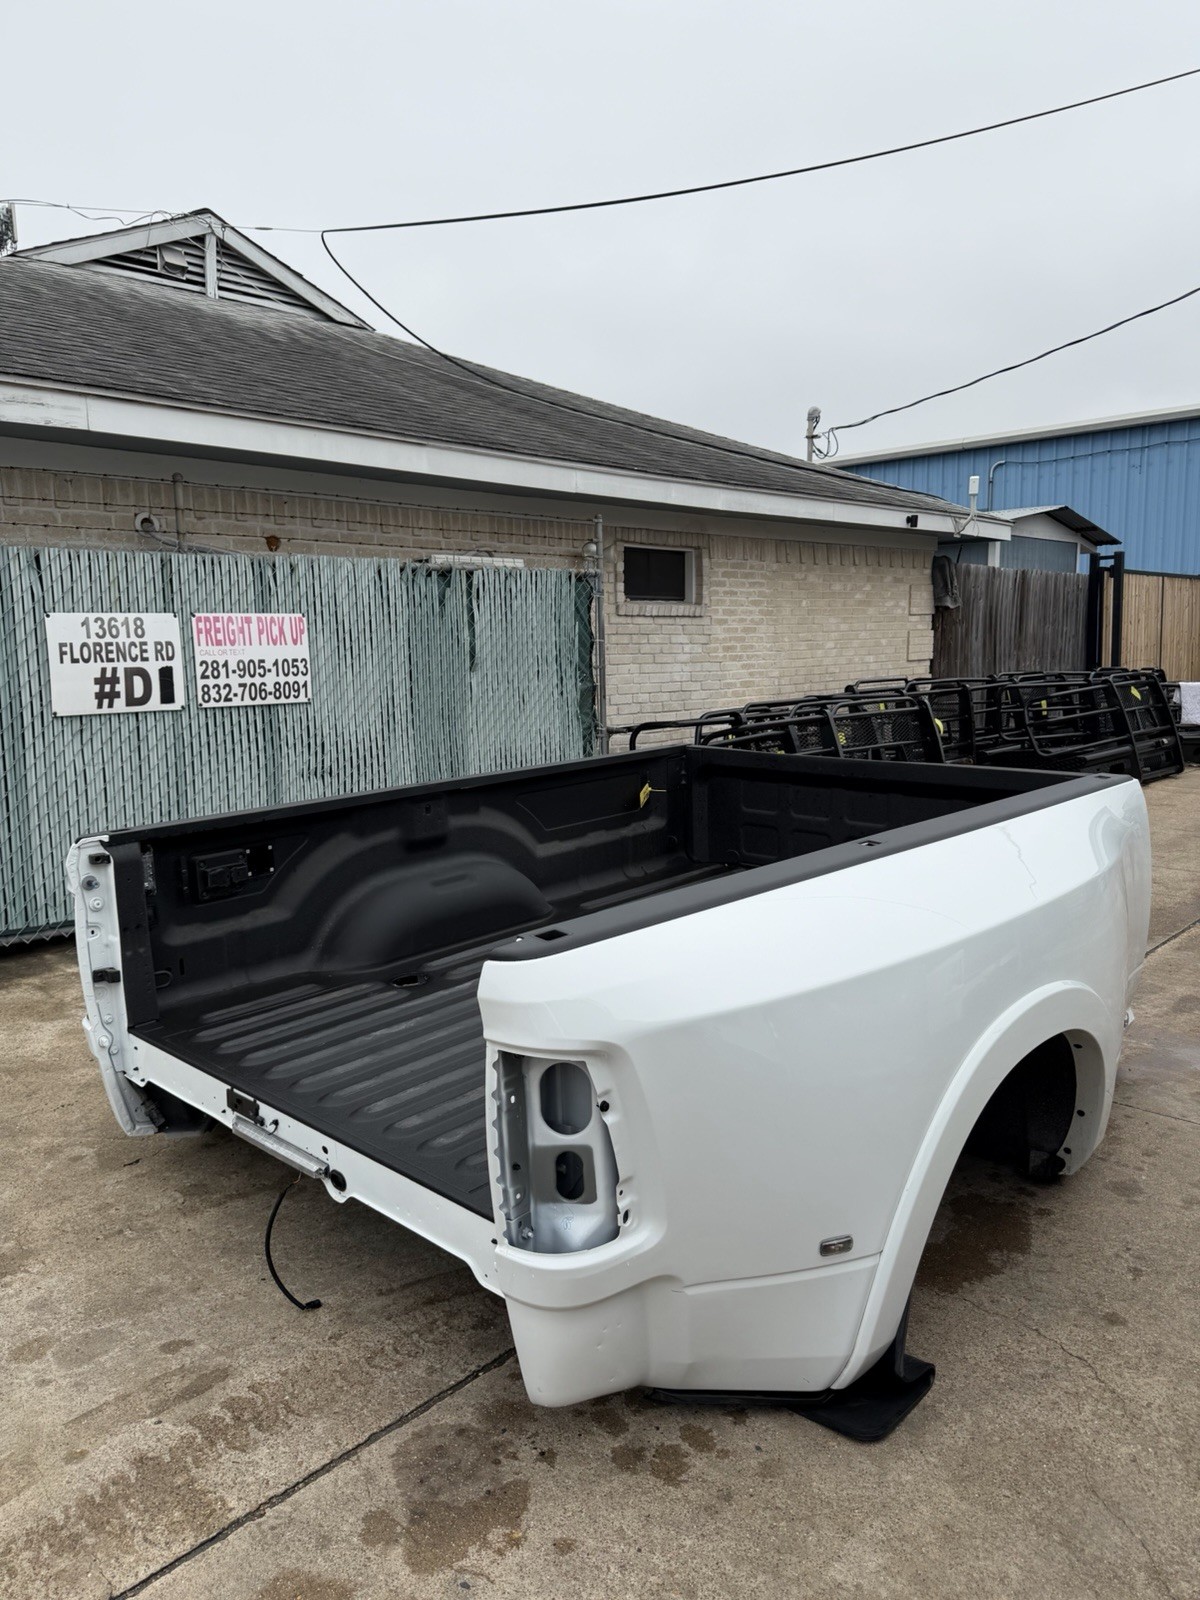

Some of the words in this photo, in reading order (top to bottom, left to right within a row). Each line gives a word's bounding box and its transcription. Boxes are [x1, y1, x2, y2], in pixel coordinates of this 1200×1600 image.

[81, 617, 145, 639] 13618
[195, 616, 252, 646] FREIGHT
[256, 616, 287, 646] PICK
[289, 616, 305, 646] UP
[59, 641, 149, 664] FLORENCE
[154, 641, 175, 661] RD
[199, 658, 309, 679] 281-905-1053
[201, 680, 309, 703] 832-706-8091
